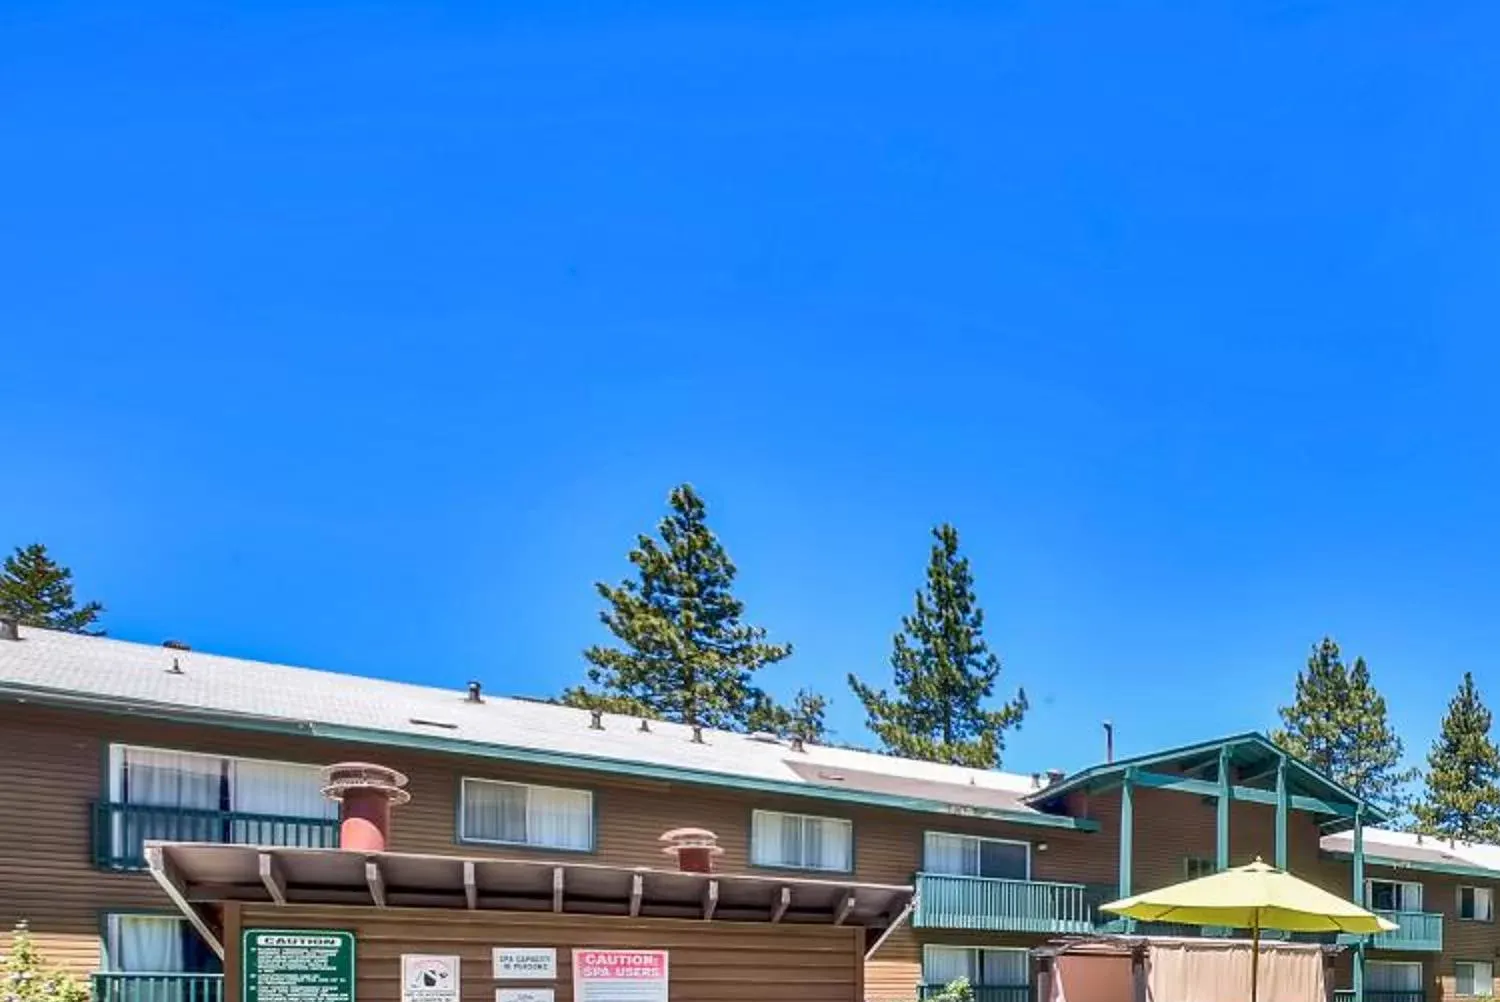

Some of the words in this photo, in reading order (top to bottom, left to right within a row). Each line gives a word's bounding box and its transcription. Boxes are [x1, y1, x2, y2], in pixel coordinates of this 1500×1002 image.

[263, 937, 335, 945] CAUTION
[583, 966, 611, 977] SPA
[615, 966, 660, 977] USERS
